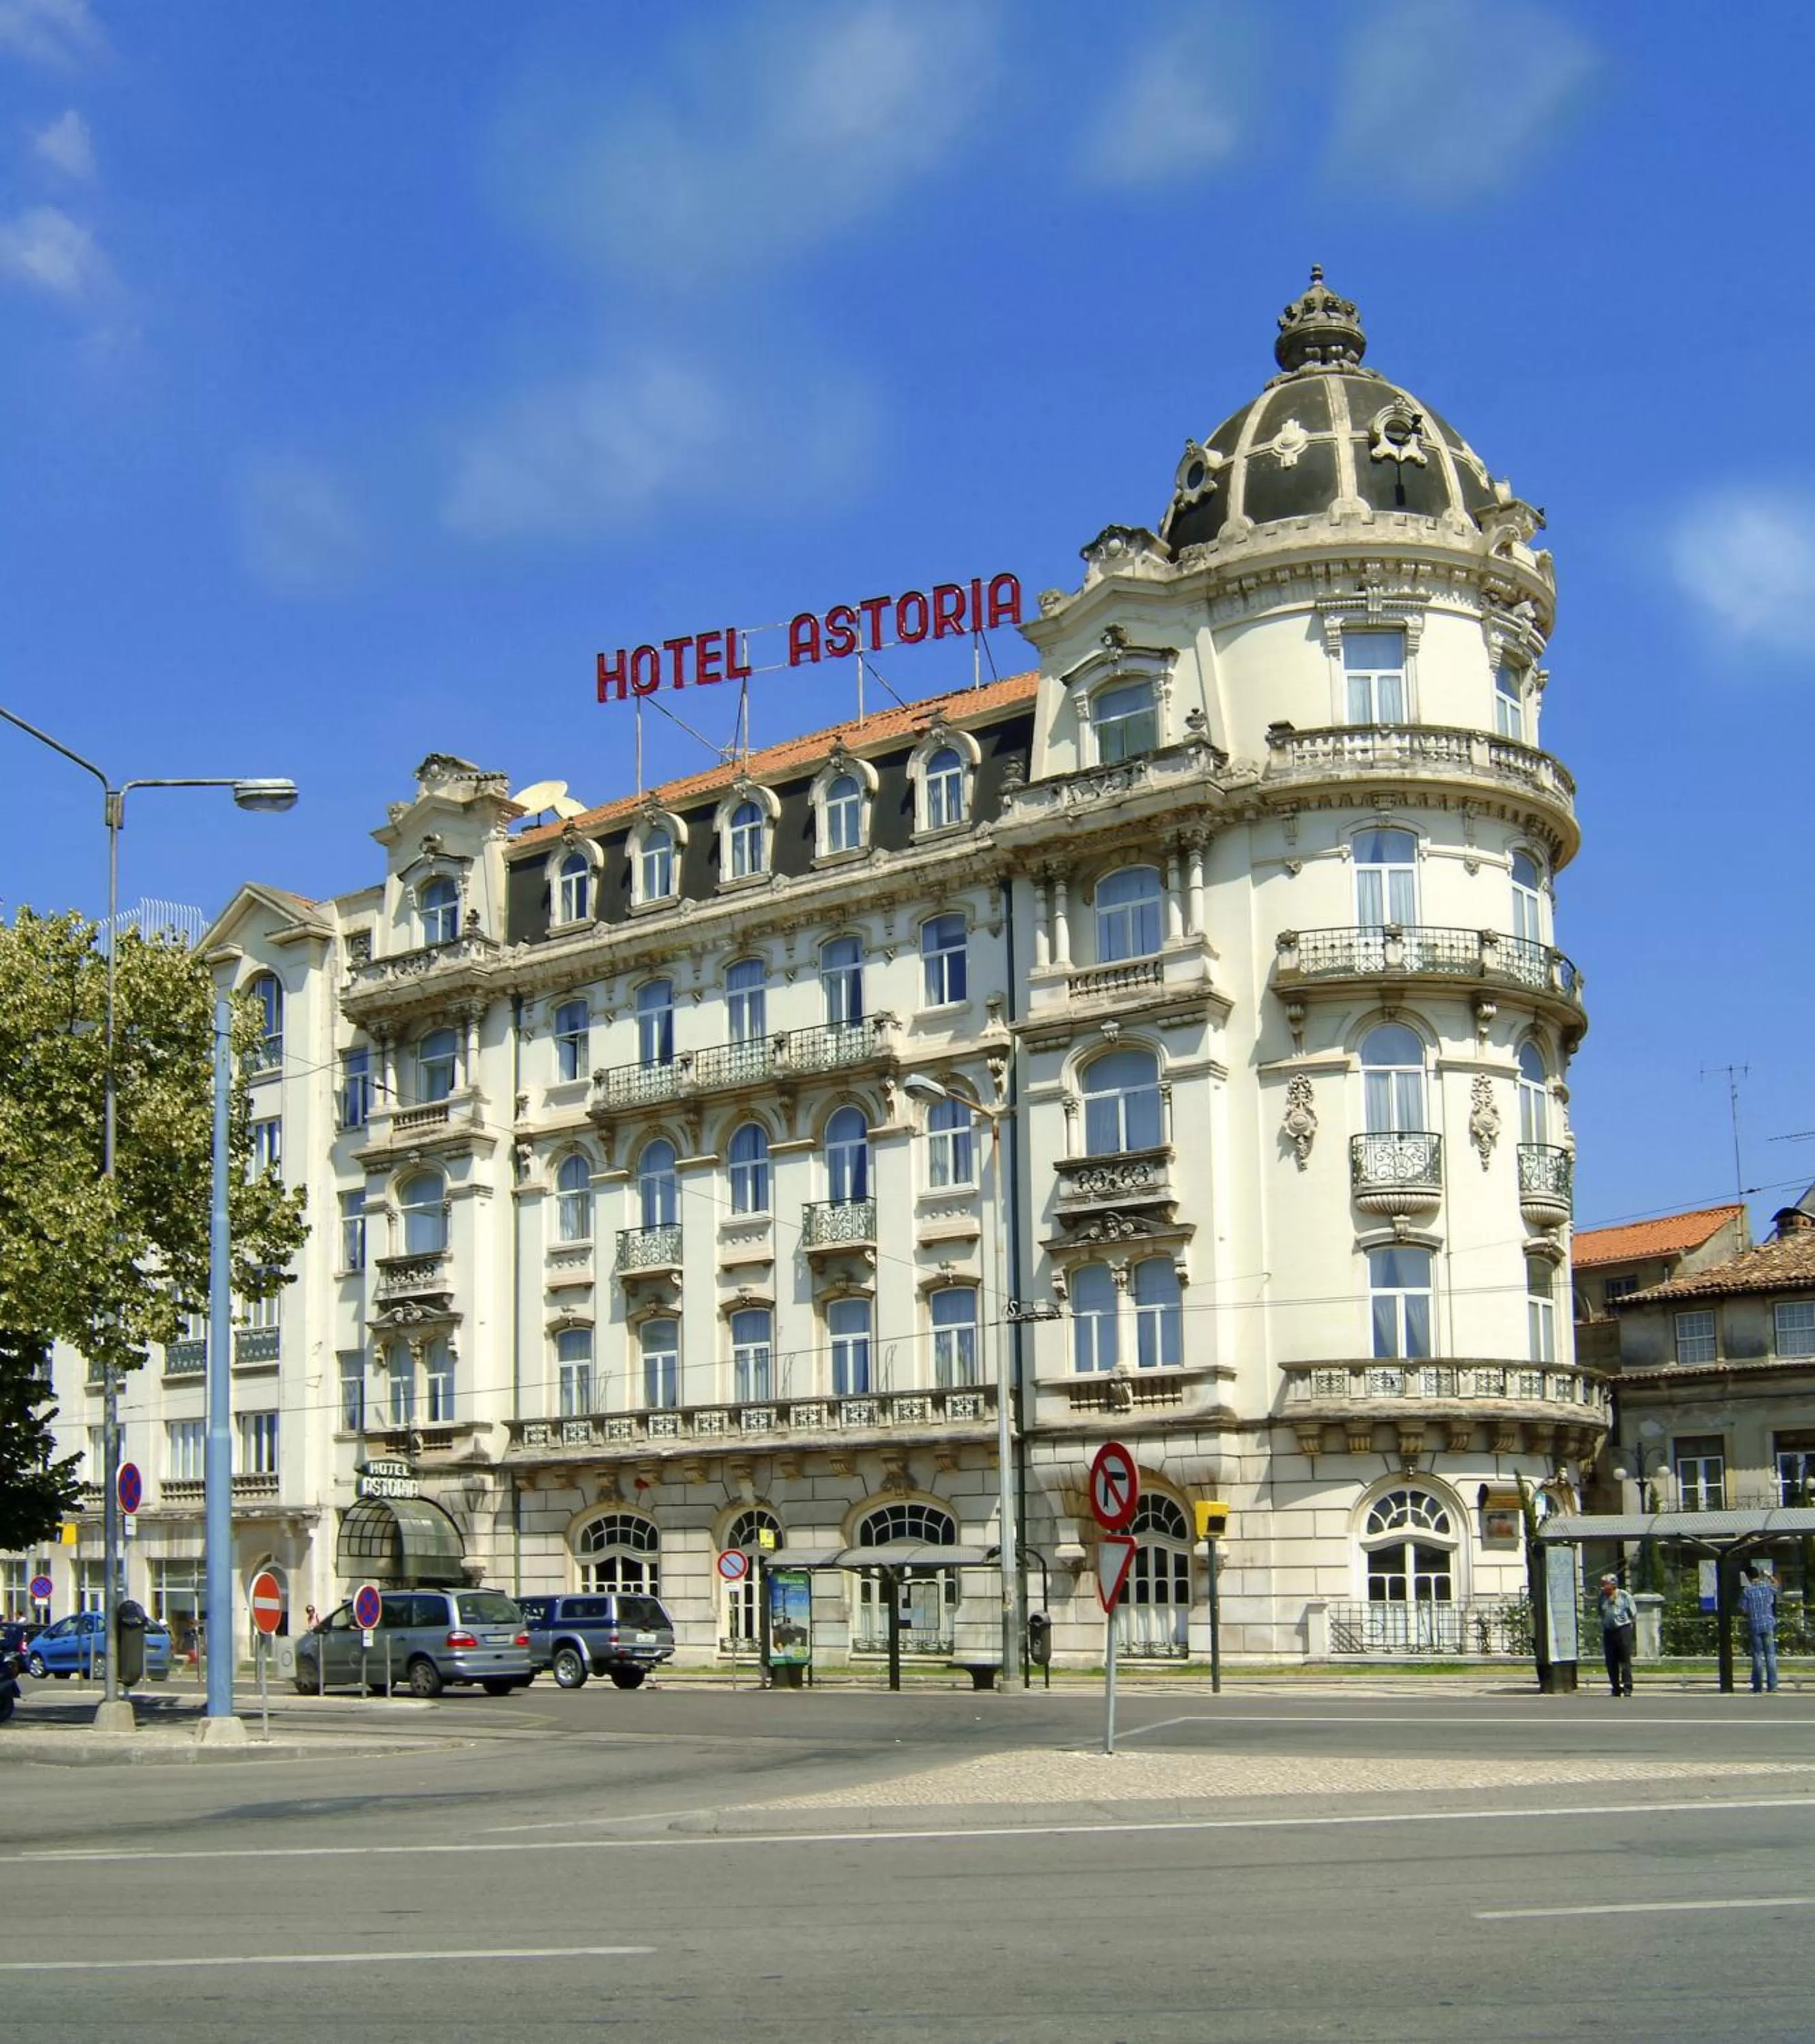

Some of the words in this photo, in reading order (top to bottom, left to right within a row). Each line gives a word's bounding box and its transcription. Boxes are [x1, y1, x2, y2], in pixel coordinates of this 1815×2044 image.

[598, 628, 751, 703] HOTEL
[789, 573, 1021, 666] ASTORIA
[370, 1462, 410, 1476] HOTEL
[362, 1476, 418, 1498] ASTORIA
